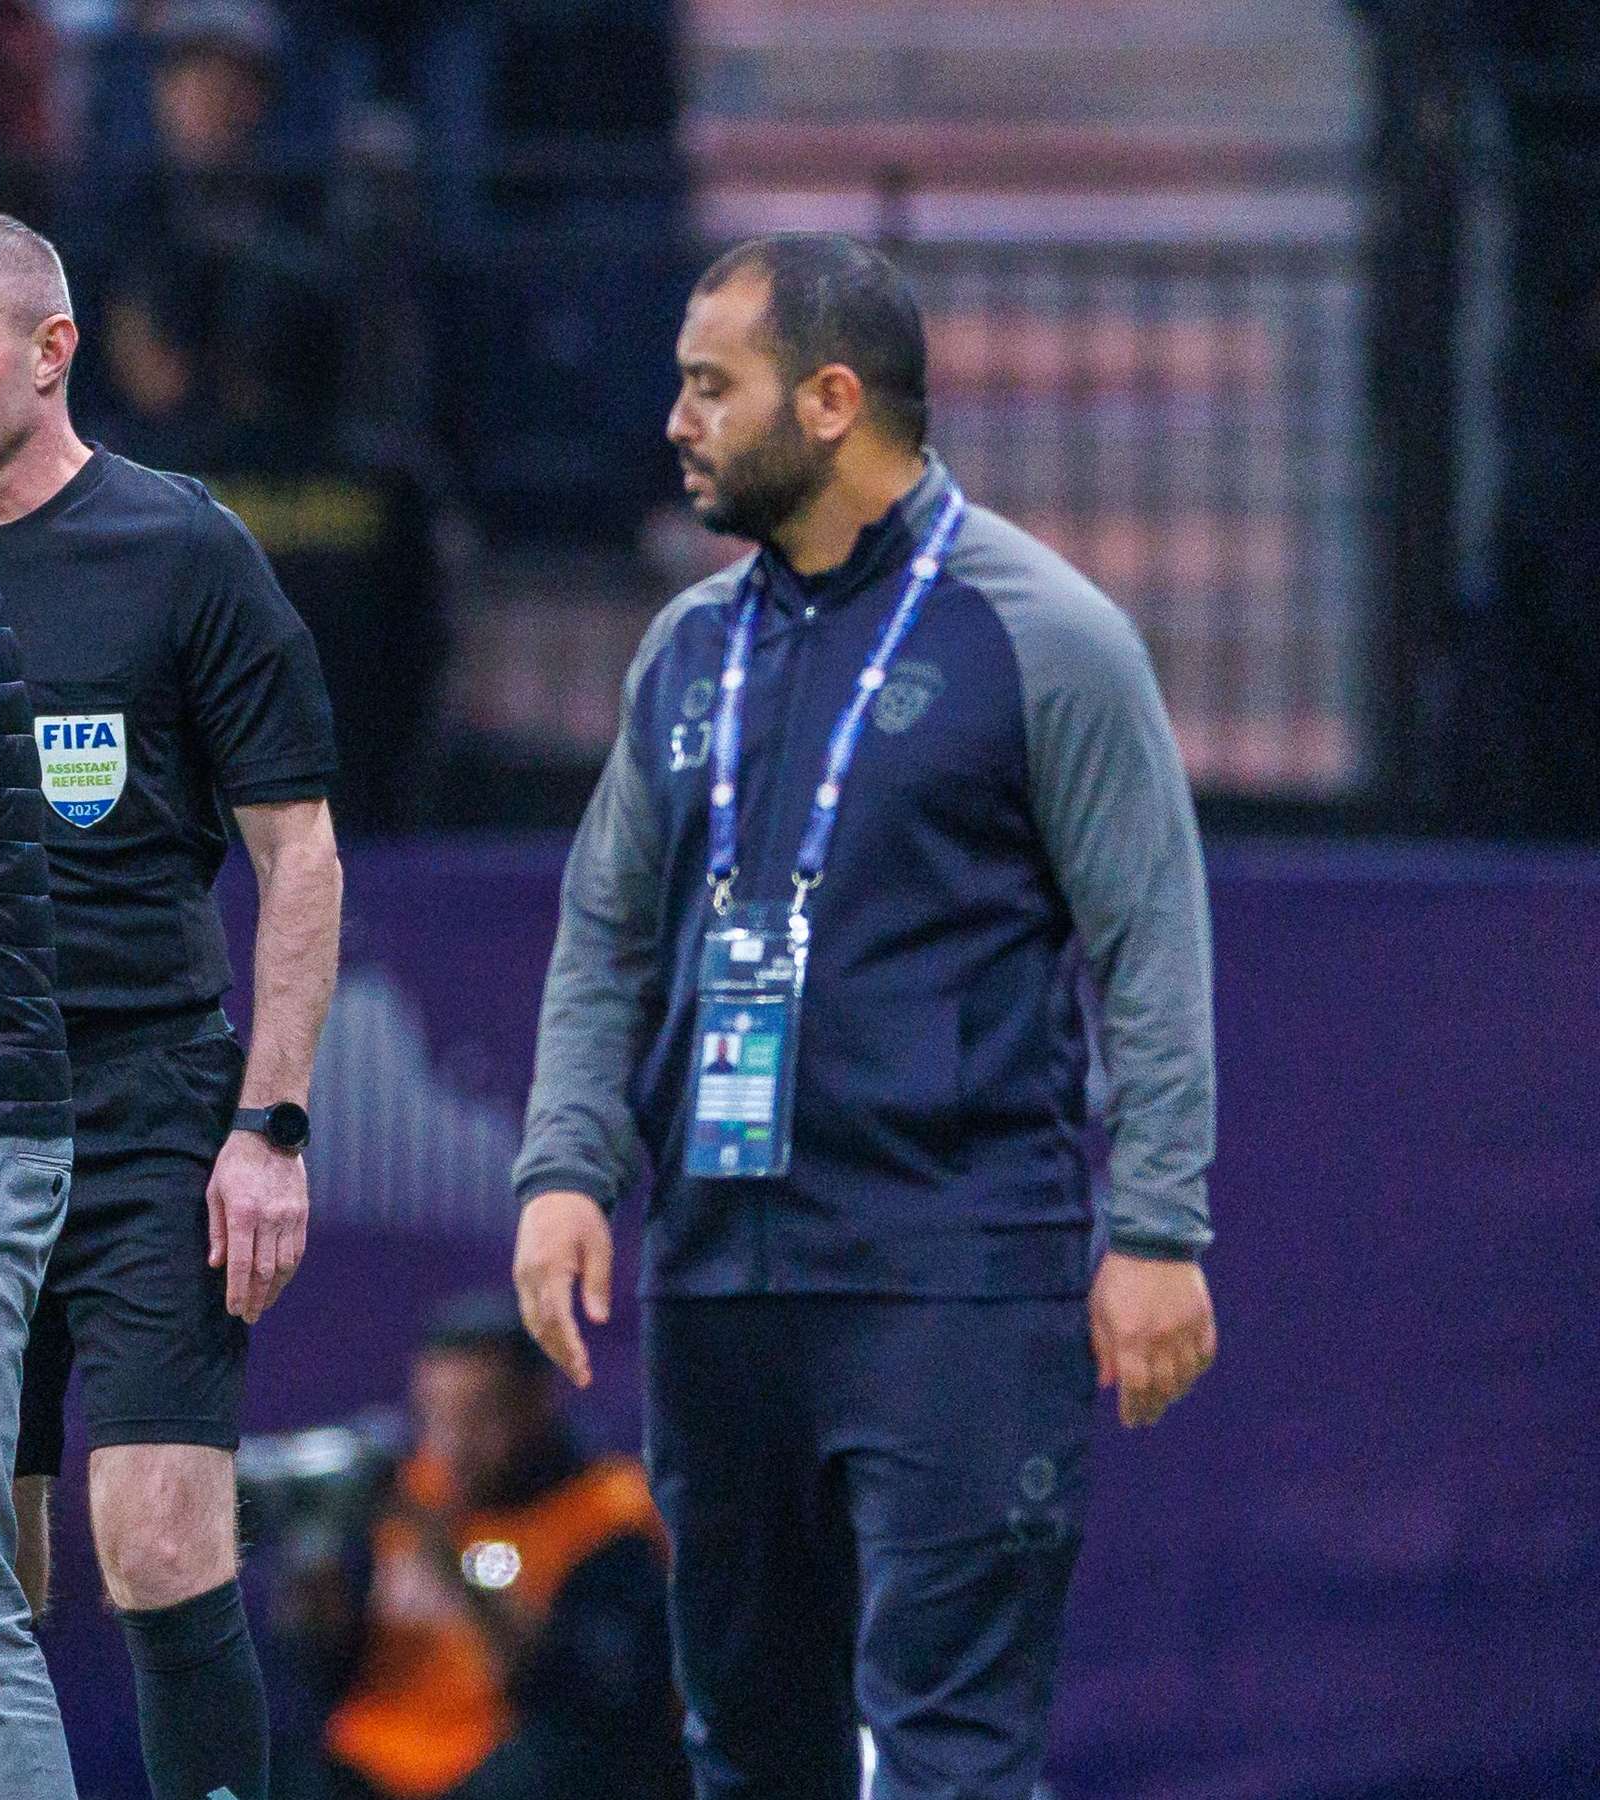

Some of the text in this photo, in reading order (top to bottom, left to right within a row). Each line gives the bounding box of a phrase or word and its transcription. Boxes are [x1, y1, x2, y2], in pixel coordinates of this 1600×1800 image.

[43, 721, 118, 750] FIFA
[46, 760, 119, 775] ASSISTANT
[51, 774, 113, 788] REFEREE
[67, 803, 101, 817] 2025
